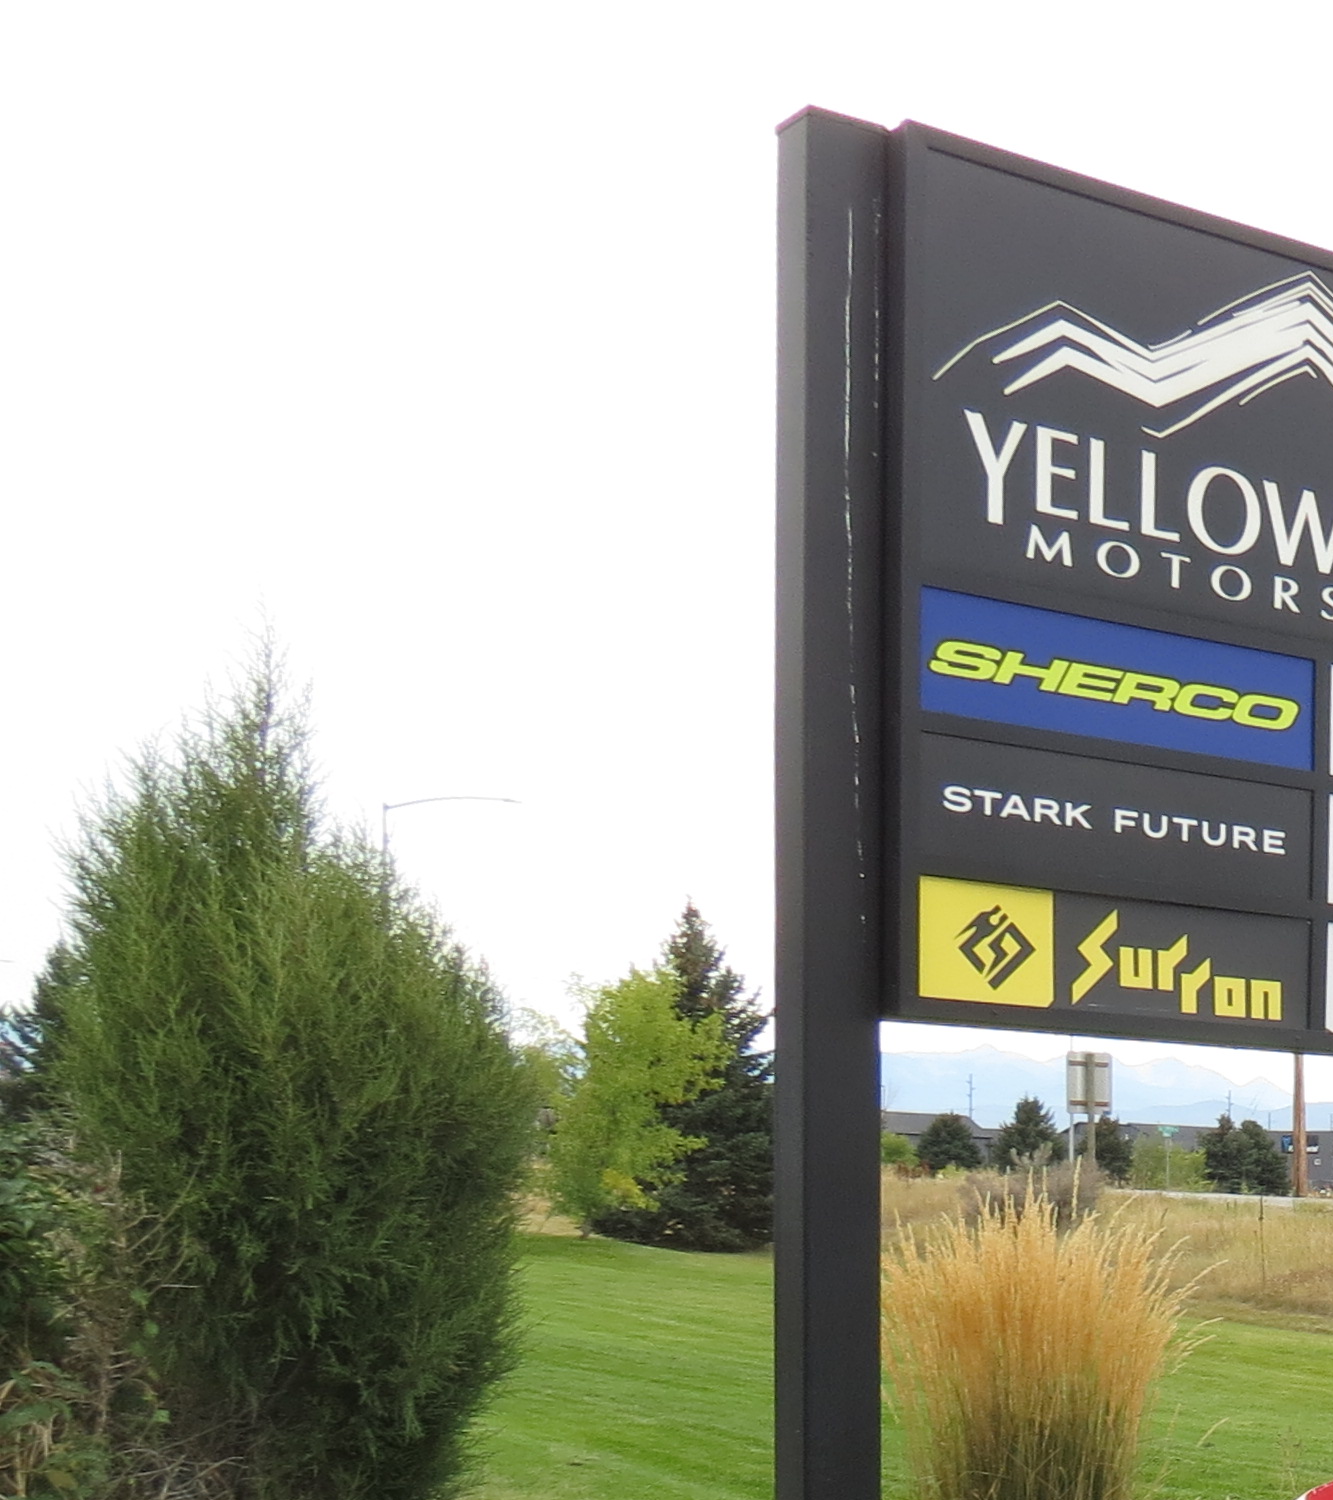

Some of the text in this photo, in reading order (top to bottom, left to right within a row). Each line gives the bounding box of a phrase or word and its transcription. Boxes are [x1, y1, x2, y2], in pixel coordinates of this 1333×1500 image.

[929, 640, 1300, 731] SHERCO
[942, 785, 1287, 856] STARK FUTURE
